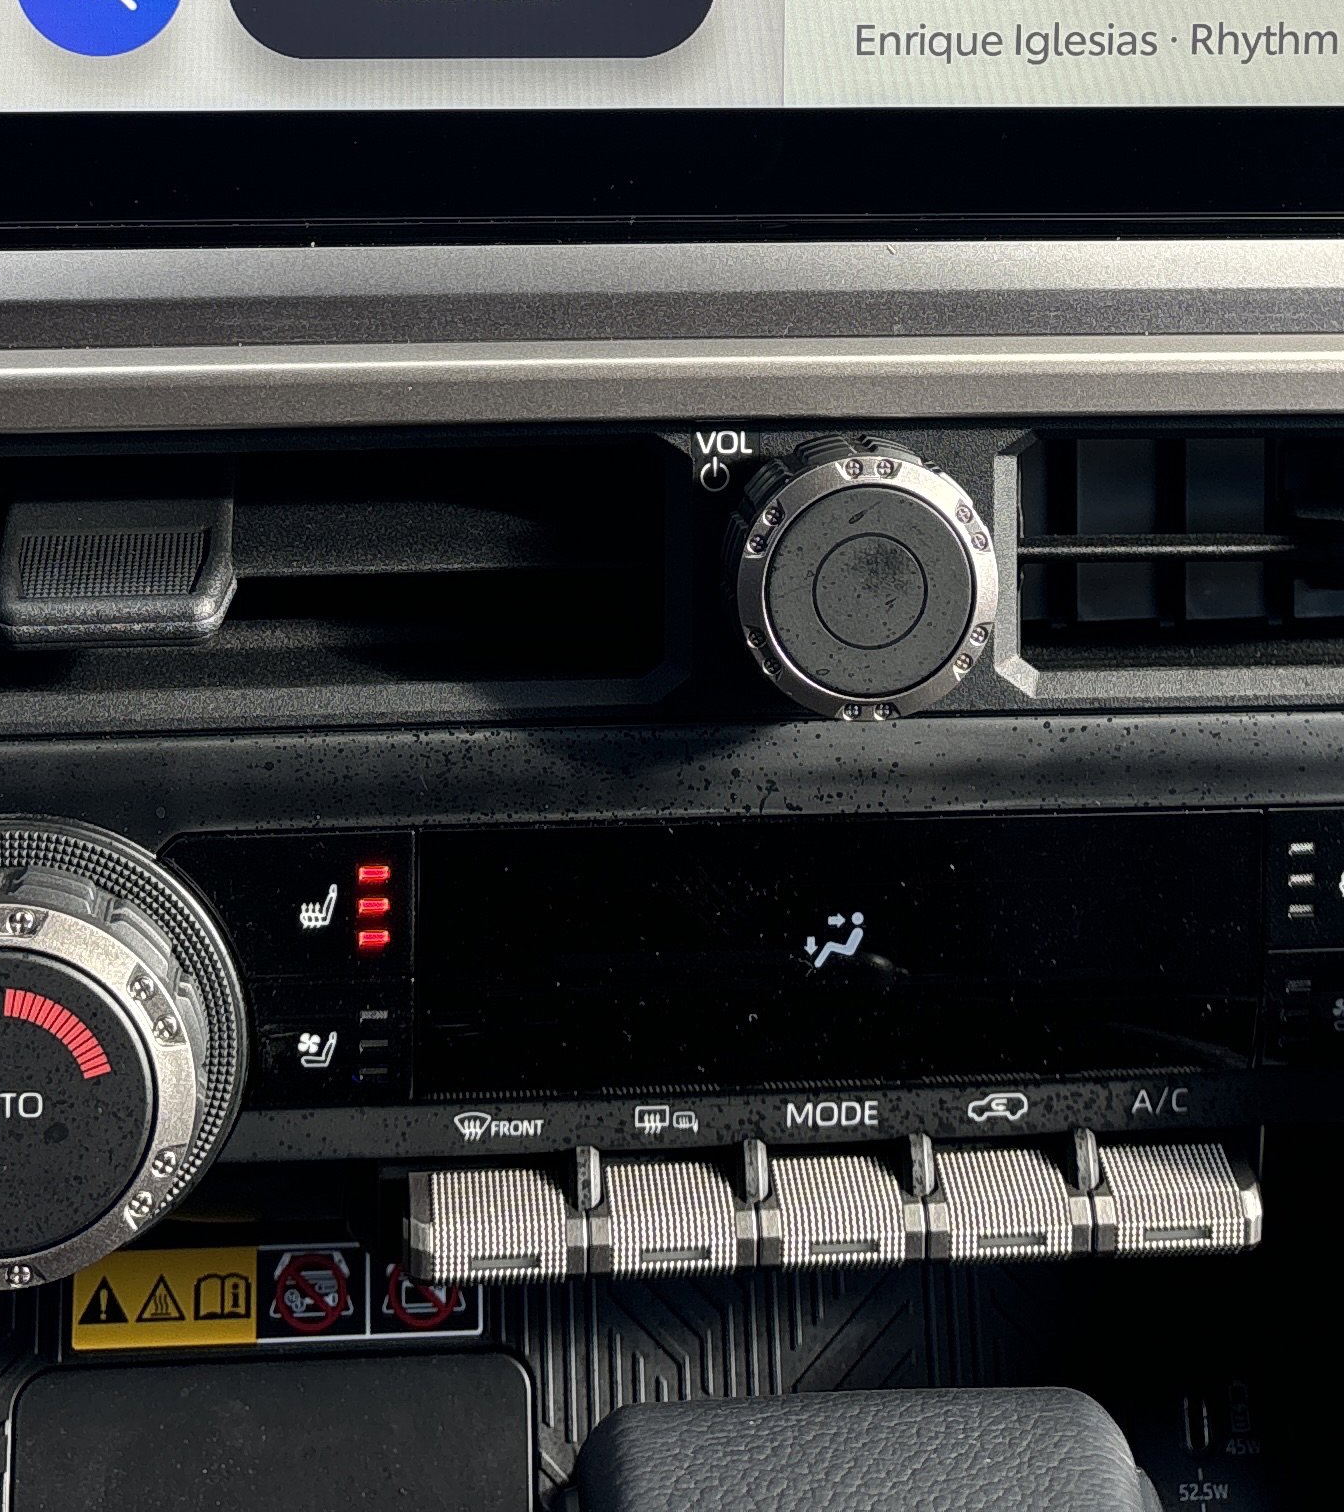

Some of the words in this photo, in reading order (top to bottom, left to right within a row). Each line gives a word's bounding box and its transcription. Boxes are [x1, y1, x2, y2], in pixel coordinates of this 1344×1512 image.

[857, 24, 1003, 64] Enrique
[1016, 22, 1157, 65] Iglesias
[1192, 22, 1337, 64] Rhythm
[696, 431, 752, 455] VOL
[1132, 1088, 1187, 1113] A/C
[787, 1101, 878, 1127] MODE
[490, 1117, 544, 1137] FRONT
[1179, 1483, 1228, 1501] 52.5W
